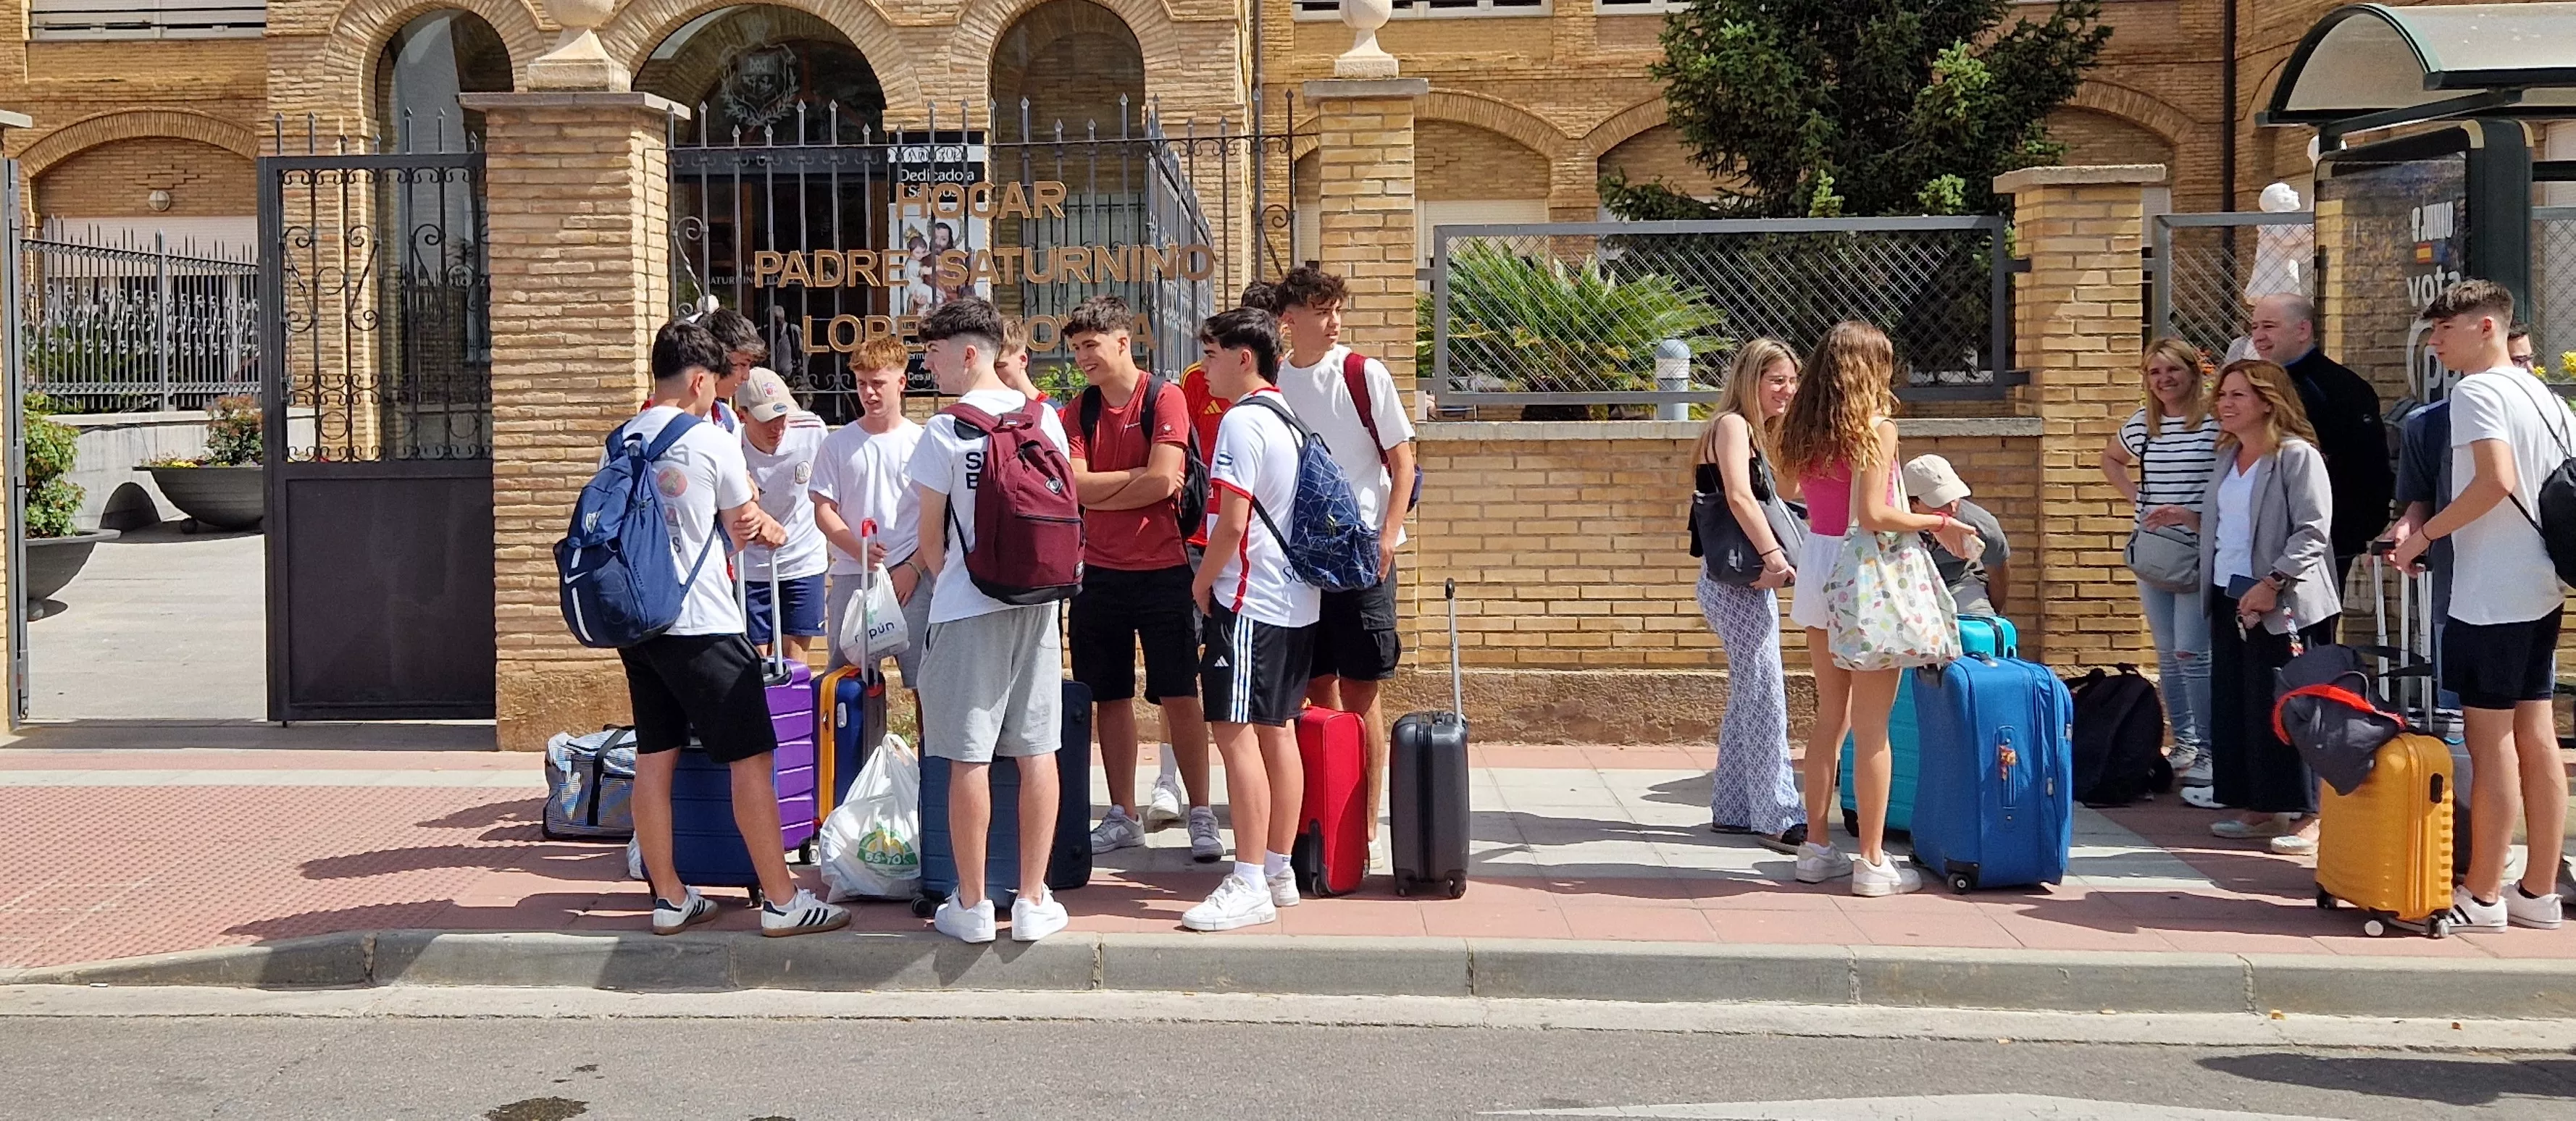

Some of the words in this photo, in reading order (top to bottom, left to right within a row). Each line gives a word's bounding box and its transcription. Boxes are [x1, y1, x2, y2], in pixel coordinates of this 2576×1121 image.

[901, 168, 963, 182] Dedicado
[967, 171, 974, 181] a
[896, 181, 1067, 220] HOGAR
[754, 248, 910, 288] PADRE
[941, 244, 1216, 285] SATURNINO
[803, 314, 925, 353] LOPE
[854, 622, 895, 643] rpún
